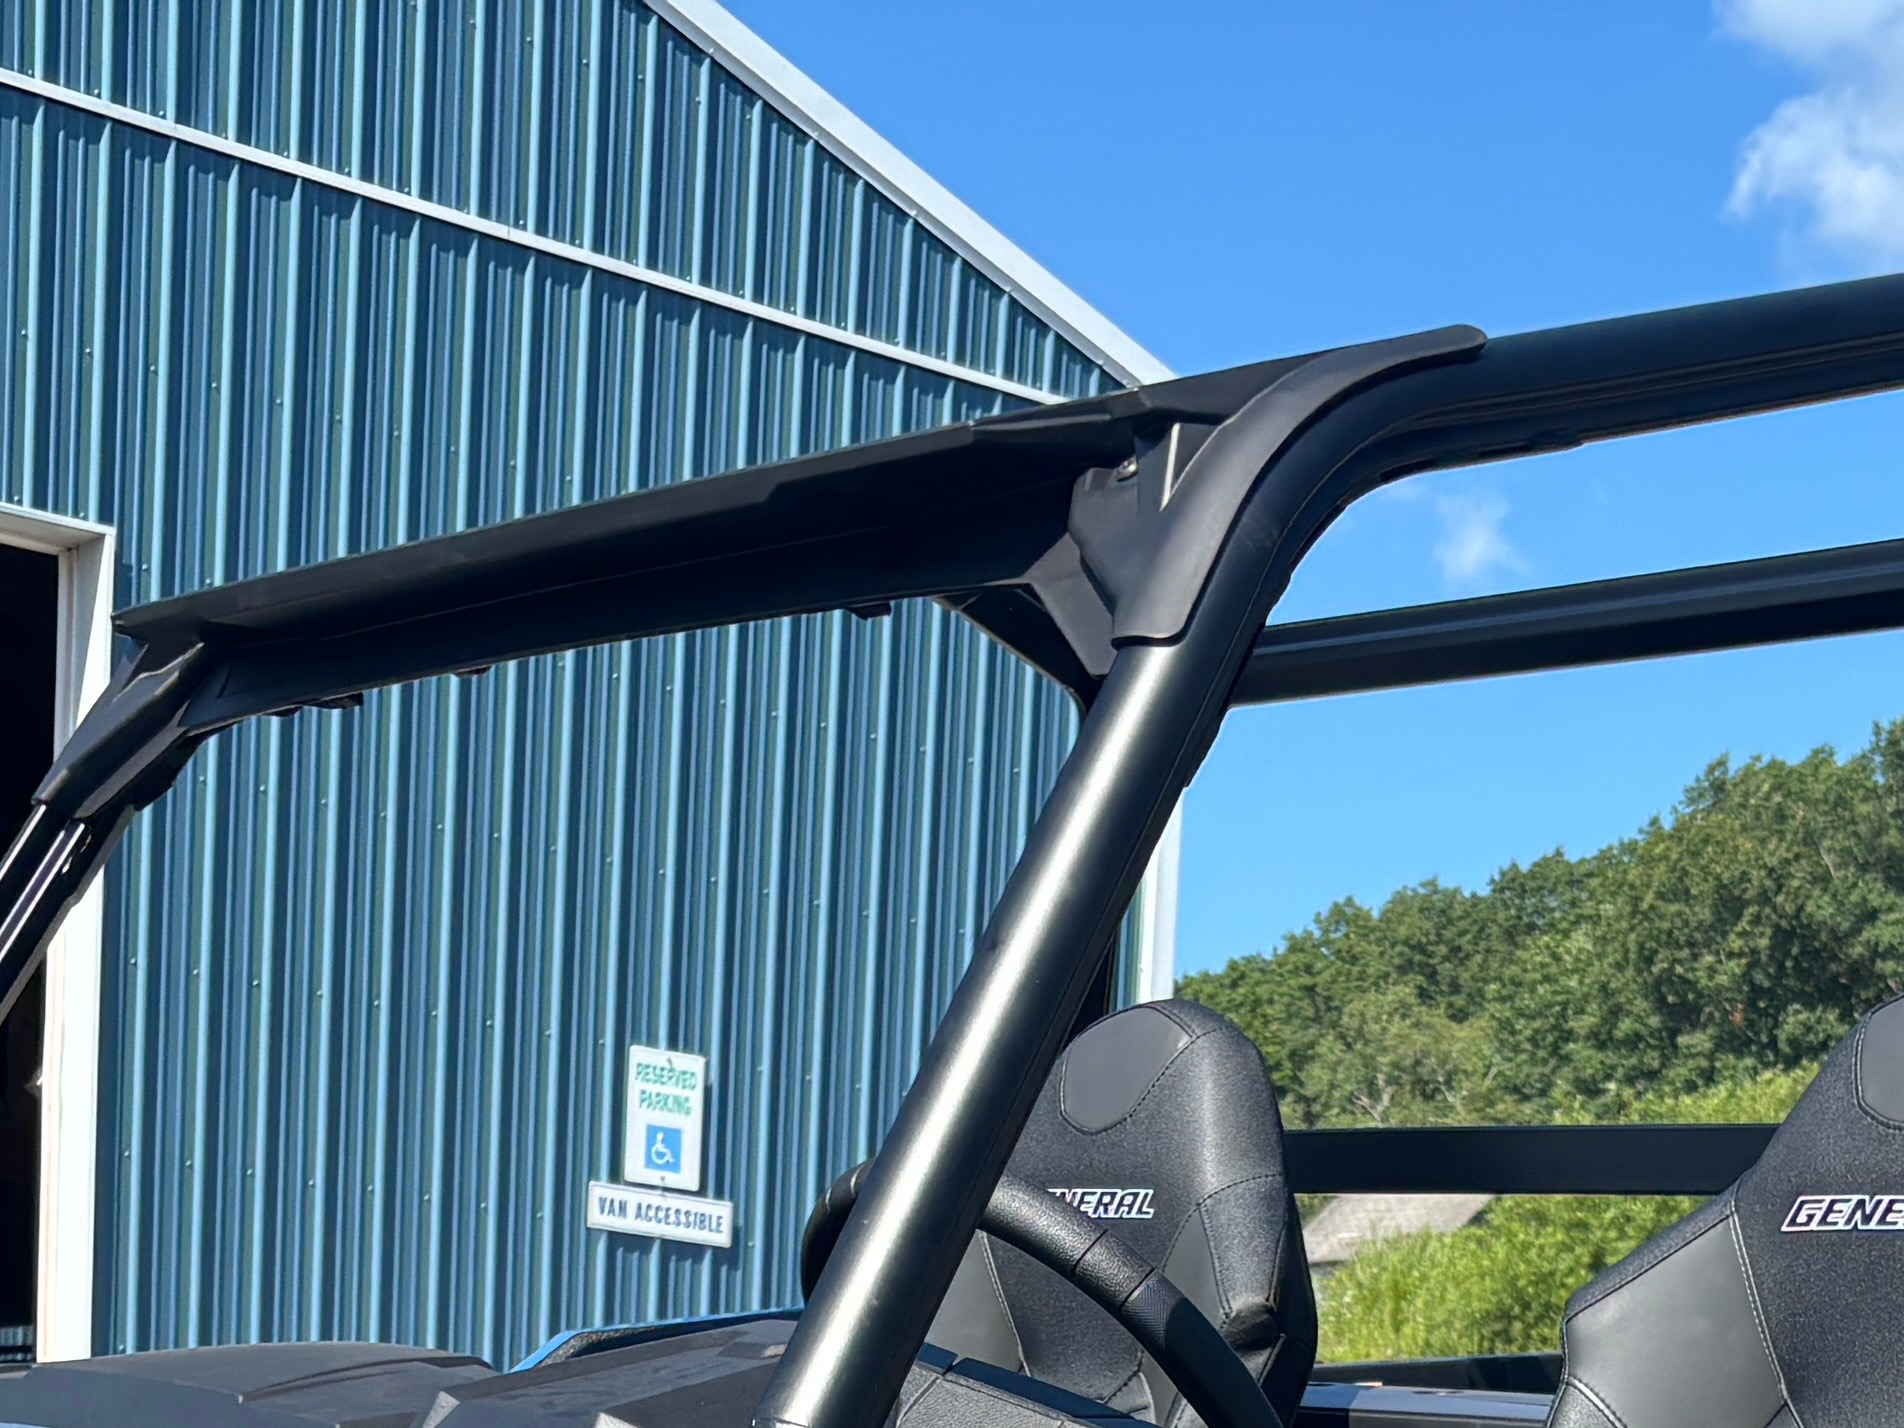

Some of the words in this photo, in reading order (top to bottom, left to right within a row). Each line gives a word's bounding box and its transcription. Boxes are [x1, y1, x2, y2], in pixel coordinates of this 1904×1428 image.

[635, 1062, 697, 1091] RESERVED
[638, 1089, 691, 1116] PARKING
[598, 1196, 628, 1219] VAN
[634, 1202, 724, 1234] ACCESSIBLE
